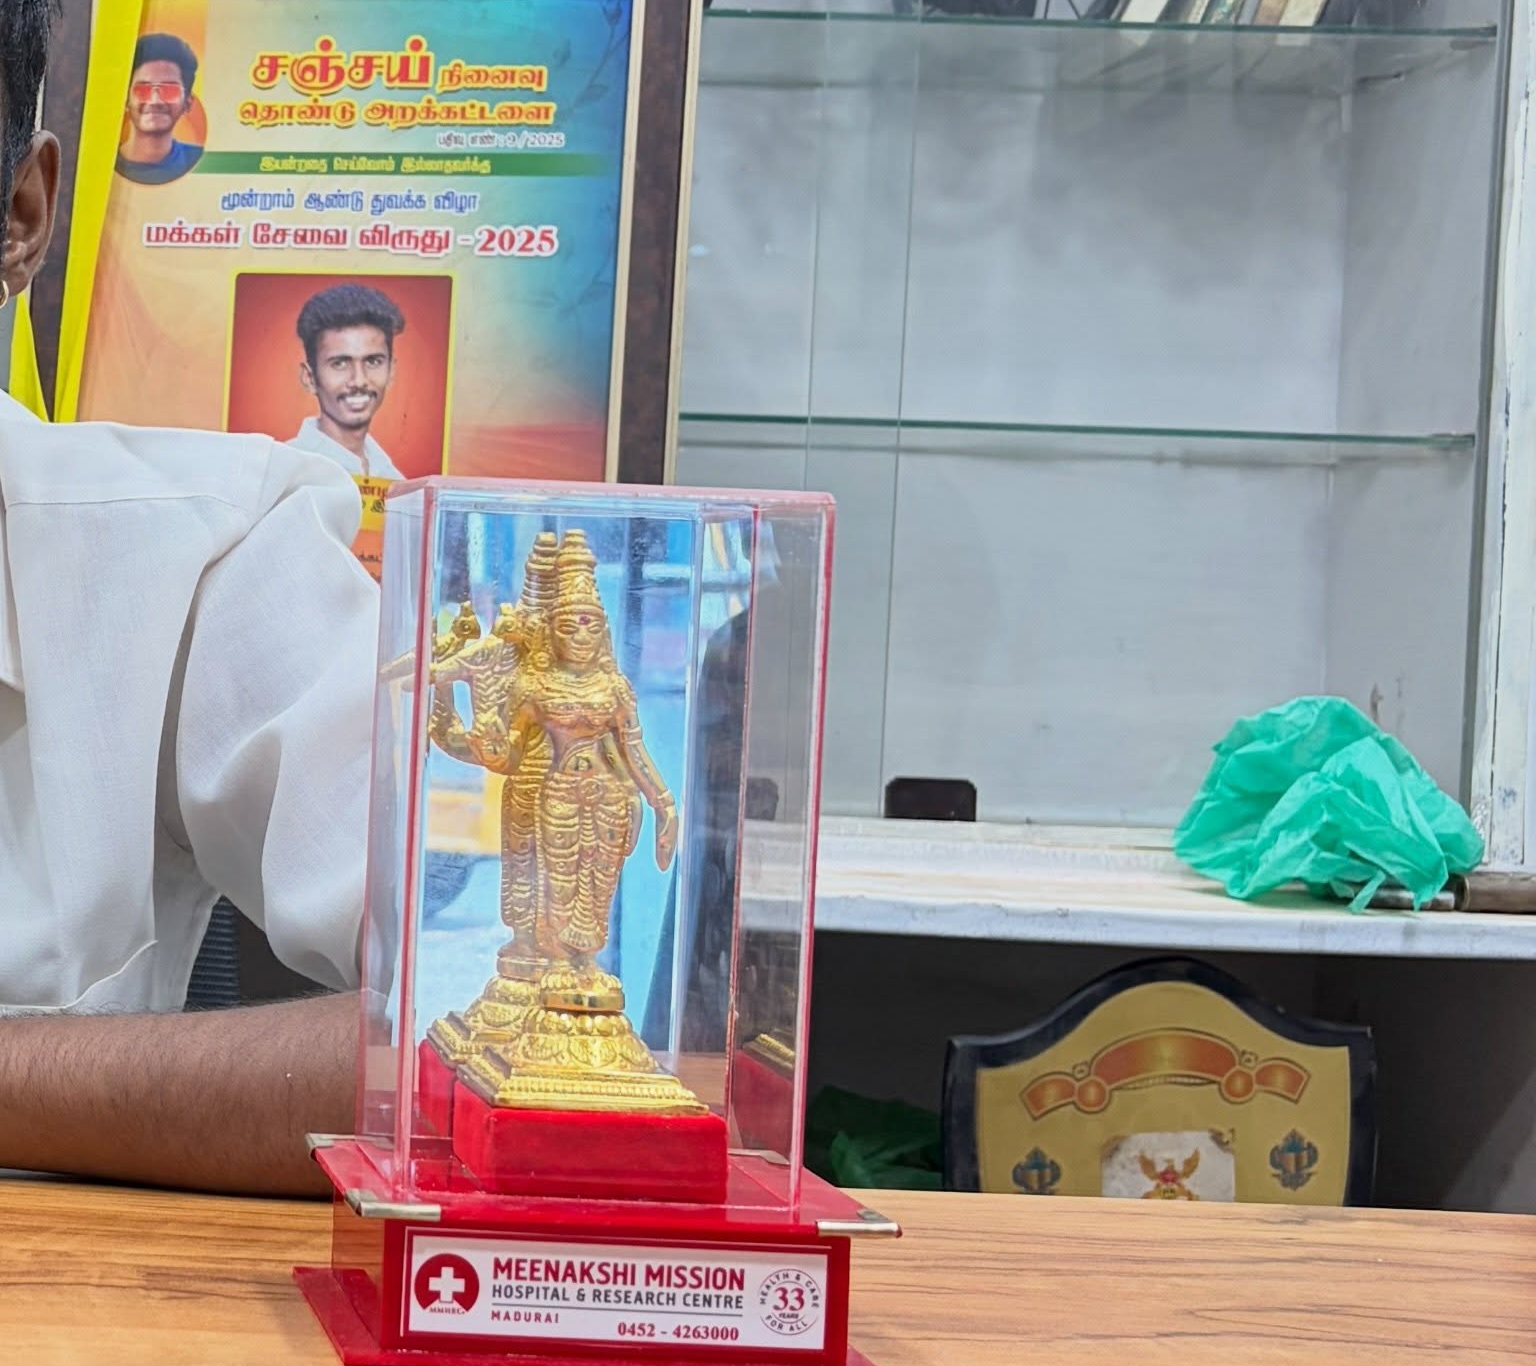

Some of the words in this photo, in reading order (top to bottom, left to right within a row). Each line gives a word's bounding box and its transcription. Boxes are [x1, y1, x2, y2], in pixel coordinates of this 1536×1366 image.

[251, 36, 435, 94] சஞ்சய்
[437, 59, 548, 93] நினைவு
[240, 96, 356, 127] தொண்டு
[363, 95, 556, 131] அறக்கட்டளை
[221, 188, 295, 212] மூன்றாம்
[303, 188, 364, 212] ஆண்டு
[370, 189, 427, 216] துவக்க
[433, 189, 479, 214] விழா
[144, 219, 241, 248] மக்கள்
[251, 223, 349, 247] சேவை
[359, 223, 452, 255] விருது
[476, 225, 558, 256] 2025
[492, 1257, 637, 1286] MEENAKSHI
[644, 1263, 745, 1291] MISSION
[492, 1284, 571, 1302] HOSPITAL
[576, 1288, 586, 1302] &
[592, 1288, 676, 1306] RESEARCH
[682, 1292, 744, 1309] CENTRE
[759, 1272, 789, 1305] HEALTH
[805, 1280, 820, 1308] CARE
[772, 1287, 805, 1311] 33
[491, 1310, 560, 1324] MADURAI
[765, 1314, 784, 1331] FOR
[789, 1320, 808, 1332] ALL
[617, 1322, 656, 1337] 0452
[672, 1325, 739, 1341] 4263000
